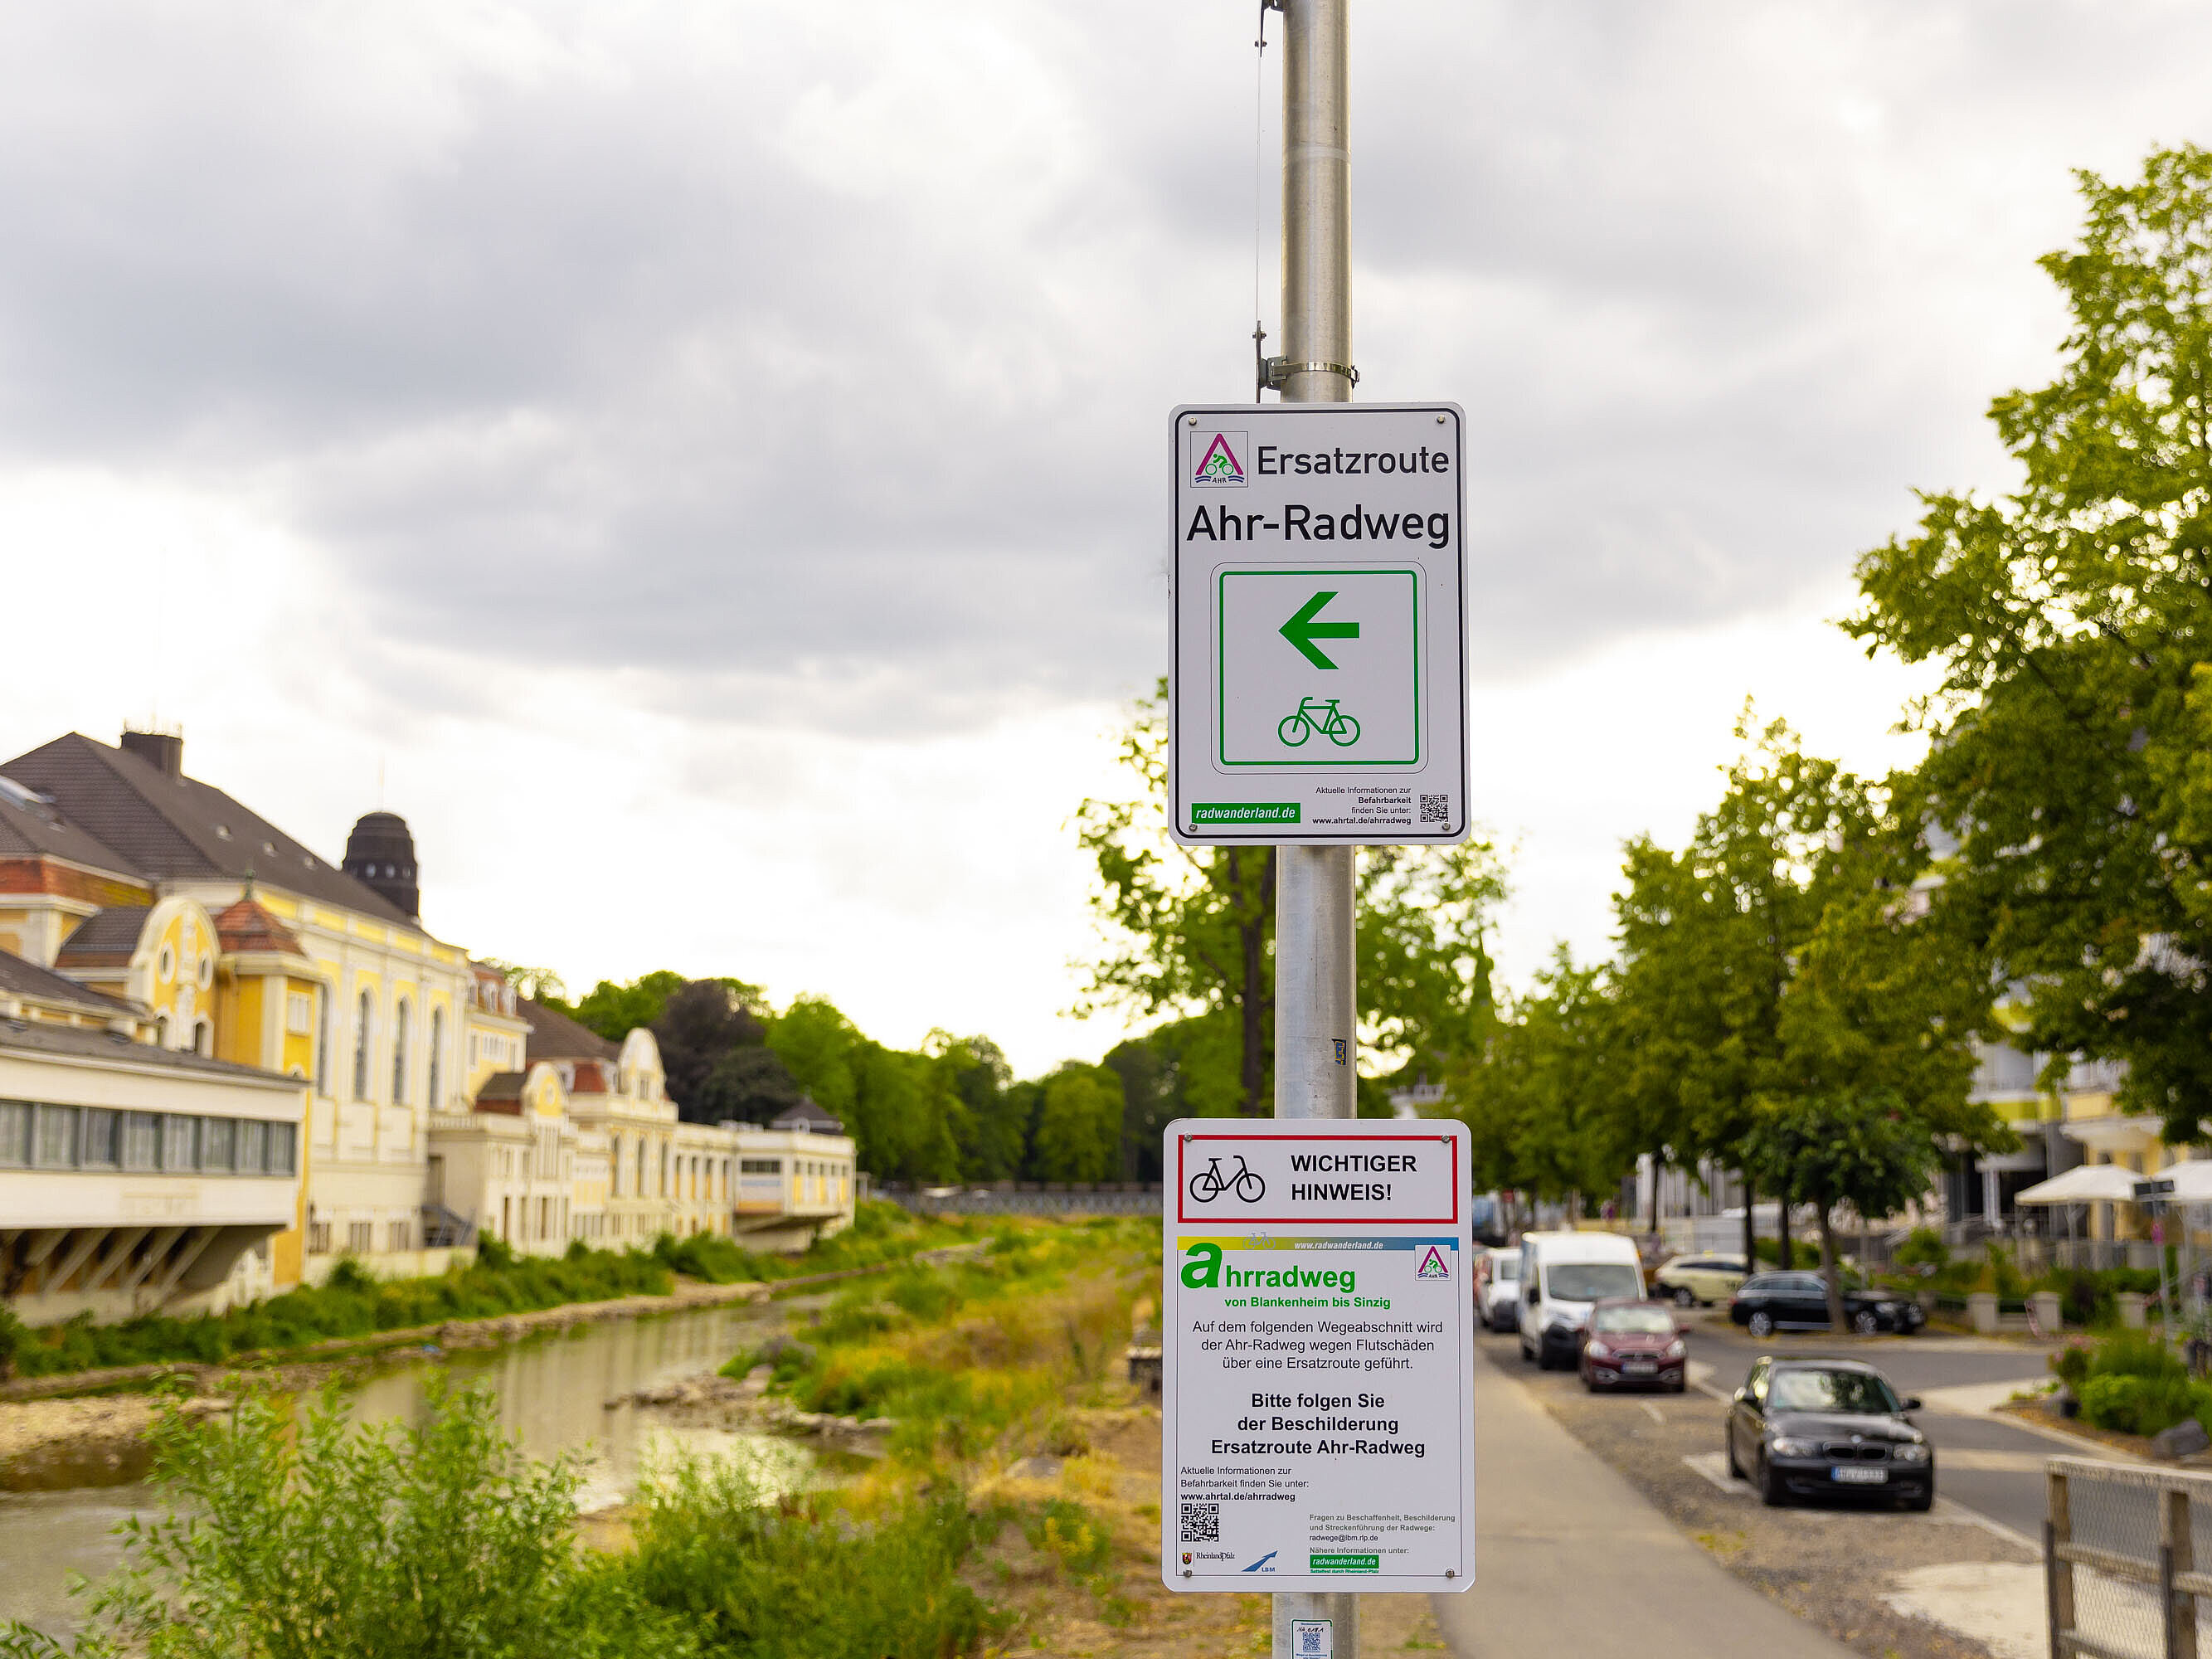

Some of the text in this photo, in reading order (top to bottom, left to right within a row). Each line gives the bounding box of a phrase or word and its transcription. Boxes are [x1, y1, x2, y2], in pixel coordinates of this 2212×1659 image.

[1258, 446, 1449, 474] Ersatzroute
[1186, 504, 1449, 549] Ahr-Radweg
[1196, 807, 1295, 819] radwanderland.de
[1291, 1155, 1417, 1172] WICHTIGER
[1291, 1184, 1392, 1201] HINWEIS!
[1294, 1241, 1383, 1250] www.radwanderland.de
[1225, 1297, 1391, 1310] von Blankenheim bis Sinzig
[1193, 1321, 1442, 1335] Auf dem folgenden Wegeabschnitt wird
[1201, 1340, 1434, 1354] der Ahr-Radweg wegen Flutschäden
[1223, 1358, 1412, 1371] über eine Ersatzroute geführt.
[1252, 1394, 1385, 1412] Bitte folgen Sie
[1237, 1417, 1398, 1434] der Beschilderung
[1212, 1440, 1425, 1458] Ersatzroute Ahr-Radweg
[1181, 1467, 1214, 1475] Aktuelle
[1218, 1467, 1275, 1475] Informationen
[1181, 1493, 1296, 1501] www.ahrtal.de/ahrradweg
